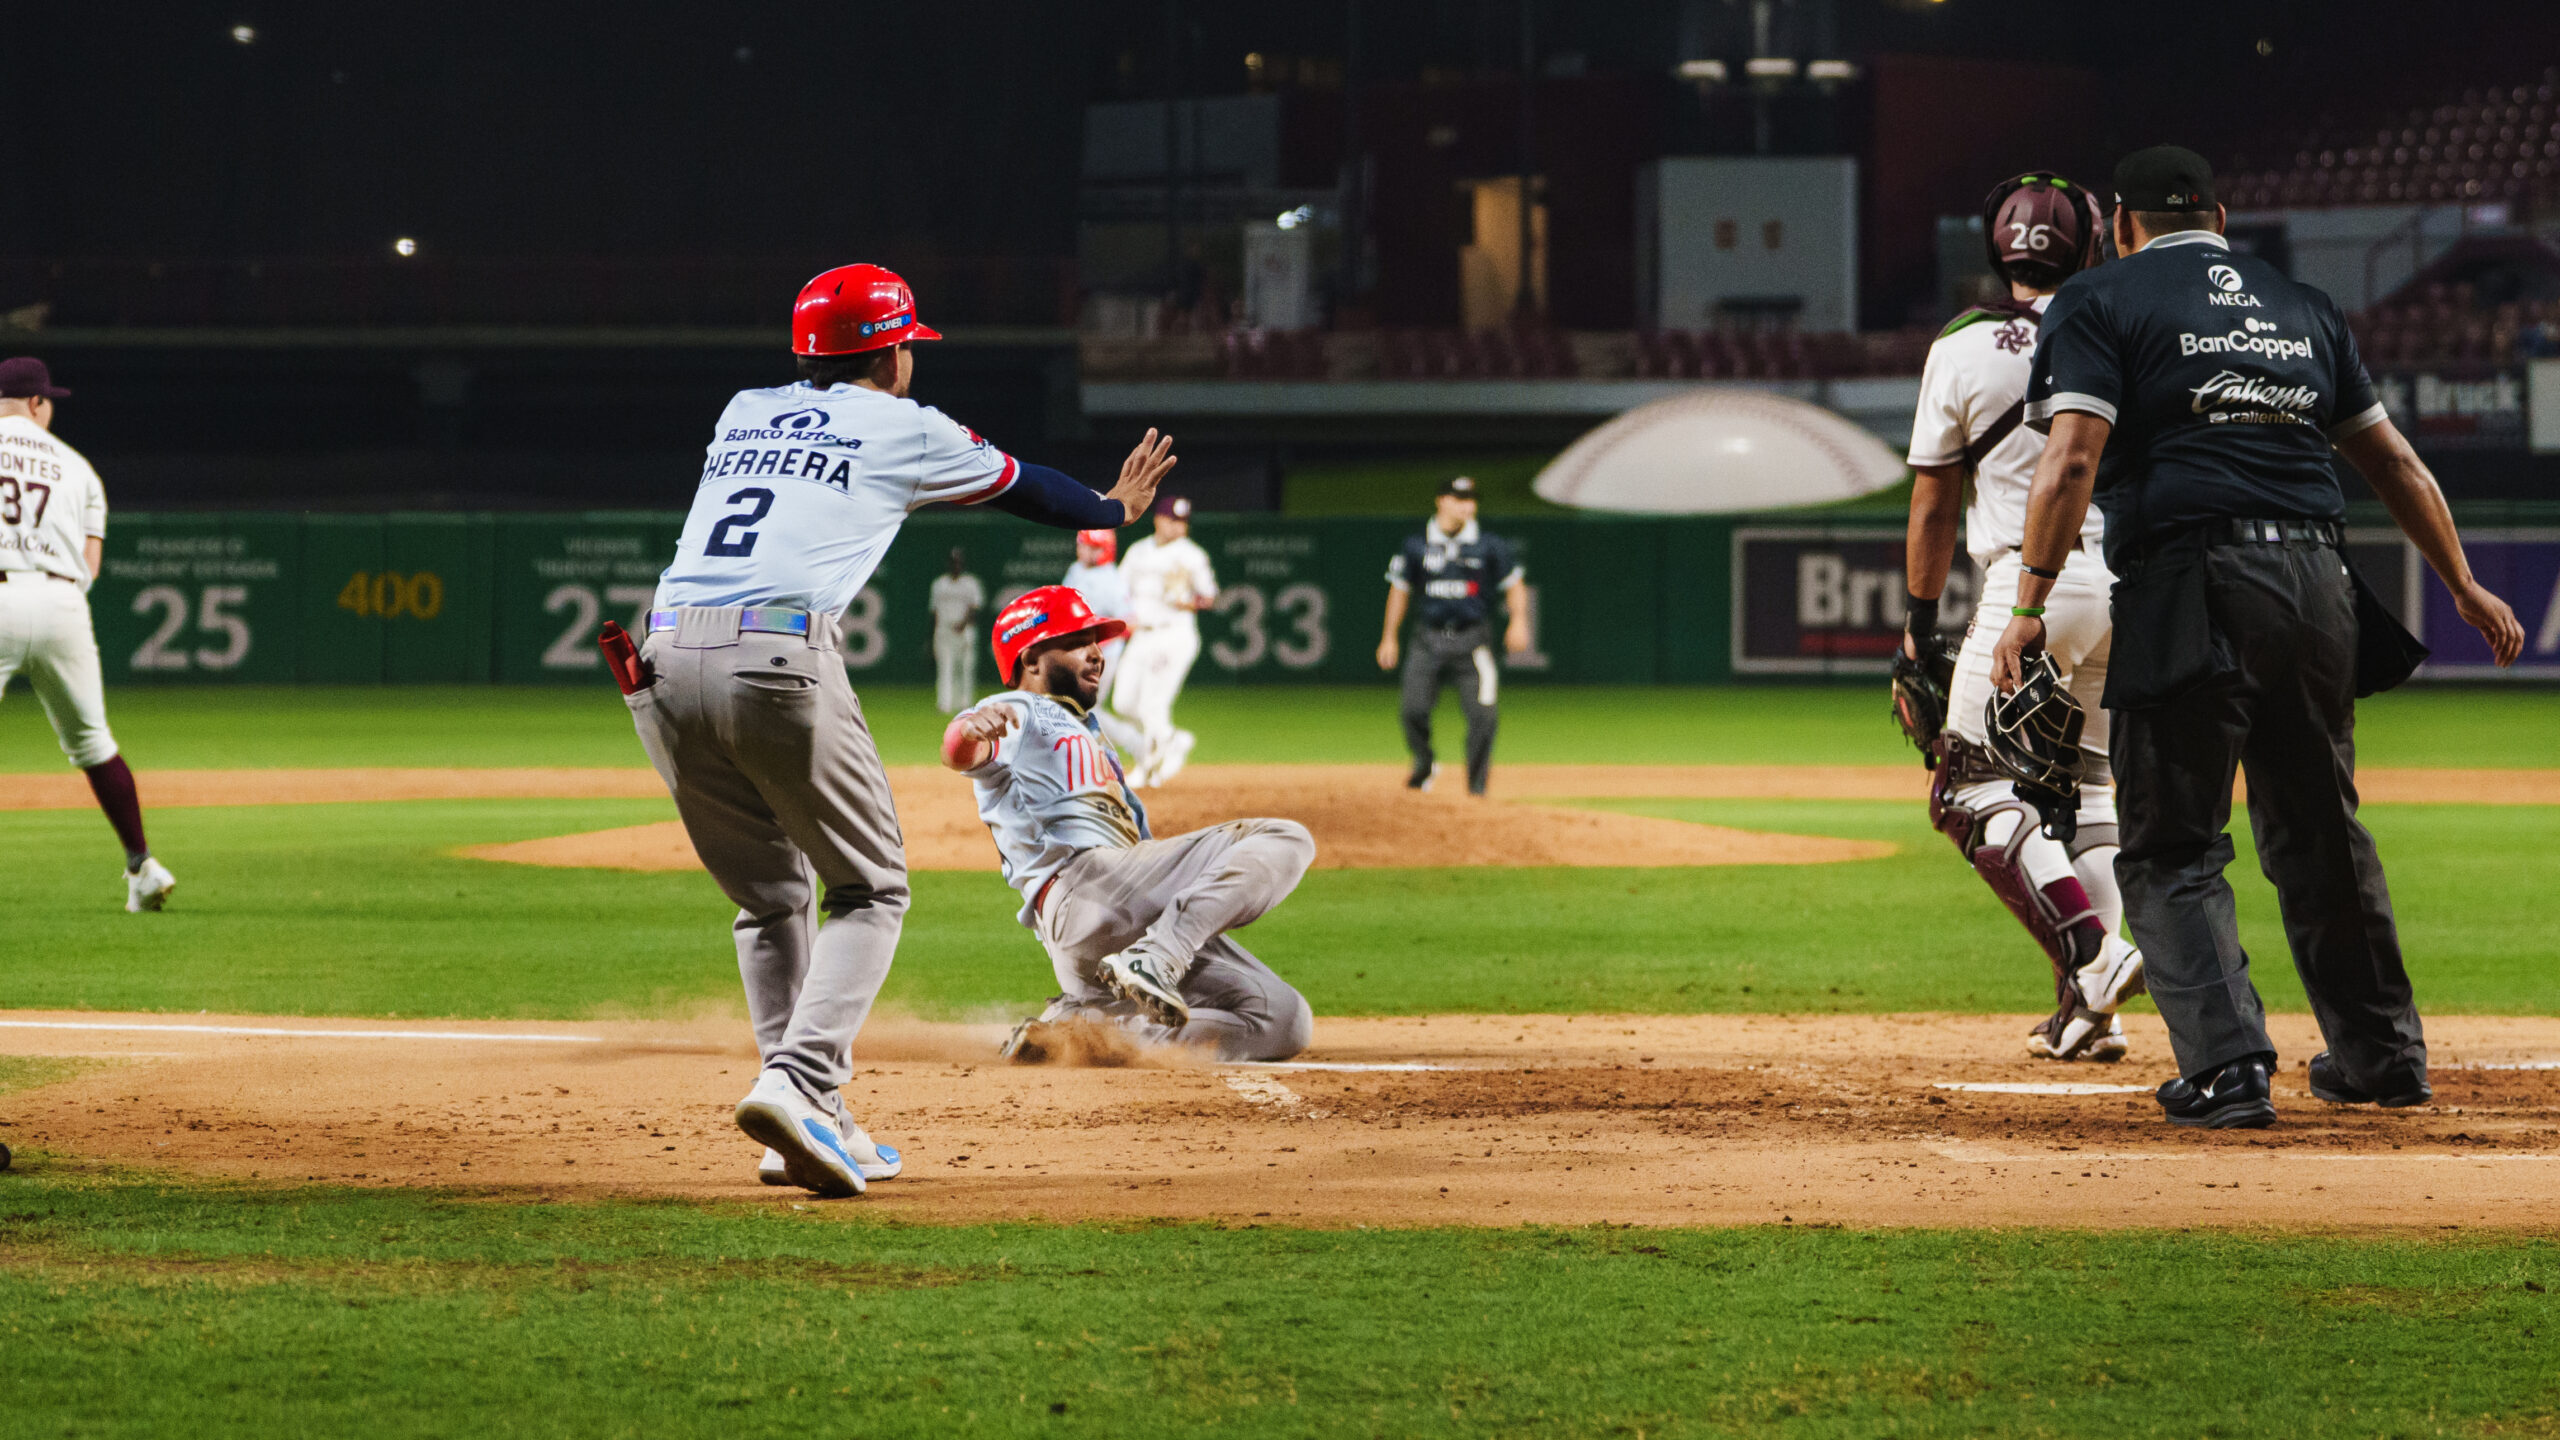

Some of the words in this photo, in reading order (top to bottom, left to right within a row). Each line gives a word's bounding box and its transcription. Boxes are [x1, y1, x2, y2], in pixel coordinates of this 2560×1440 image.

[2010, 222, 2050, 251] 26
[2208, 292, 2262, 307] MEGA
[808, 333, 816, 353] 2
[2179, 329, 2313, 360] BanCoppel
[2188, 369, 2318, 414] Caliente
[724, 428, 784, 442] Banco
[786, 430, 863, 450] Azteca
[700, 448, 850, 491] HERRERA
[0, 476, 51, 529] 37
[703, 487, 775, 557] 2
[337, 571, 444, 619] 400
[131, 585, 250, 669] 25
[541, 584, 656, 668] 27
[1212, 584, 1329, 668] 33
